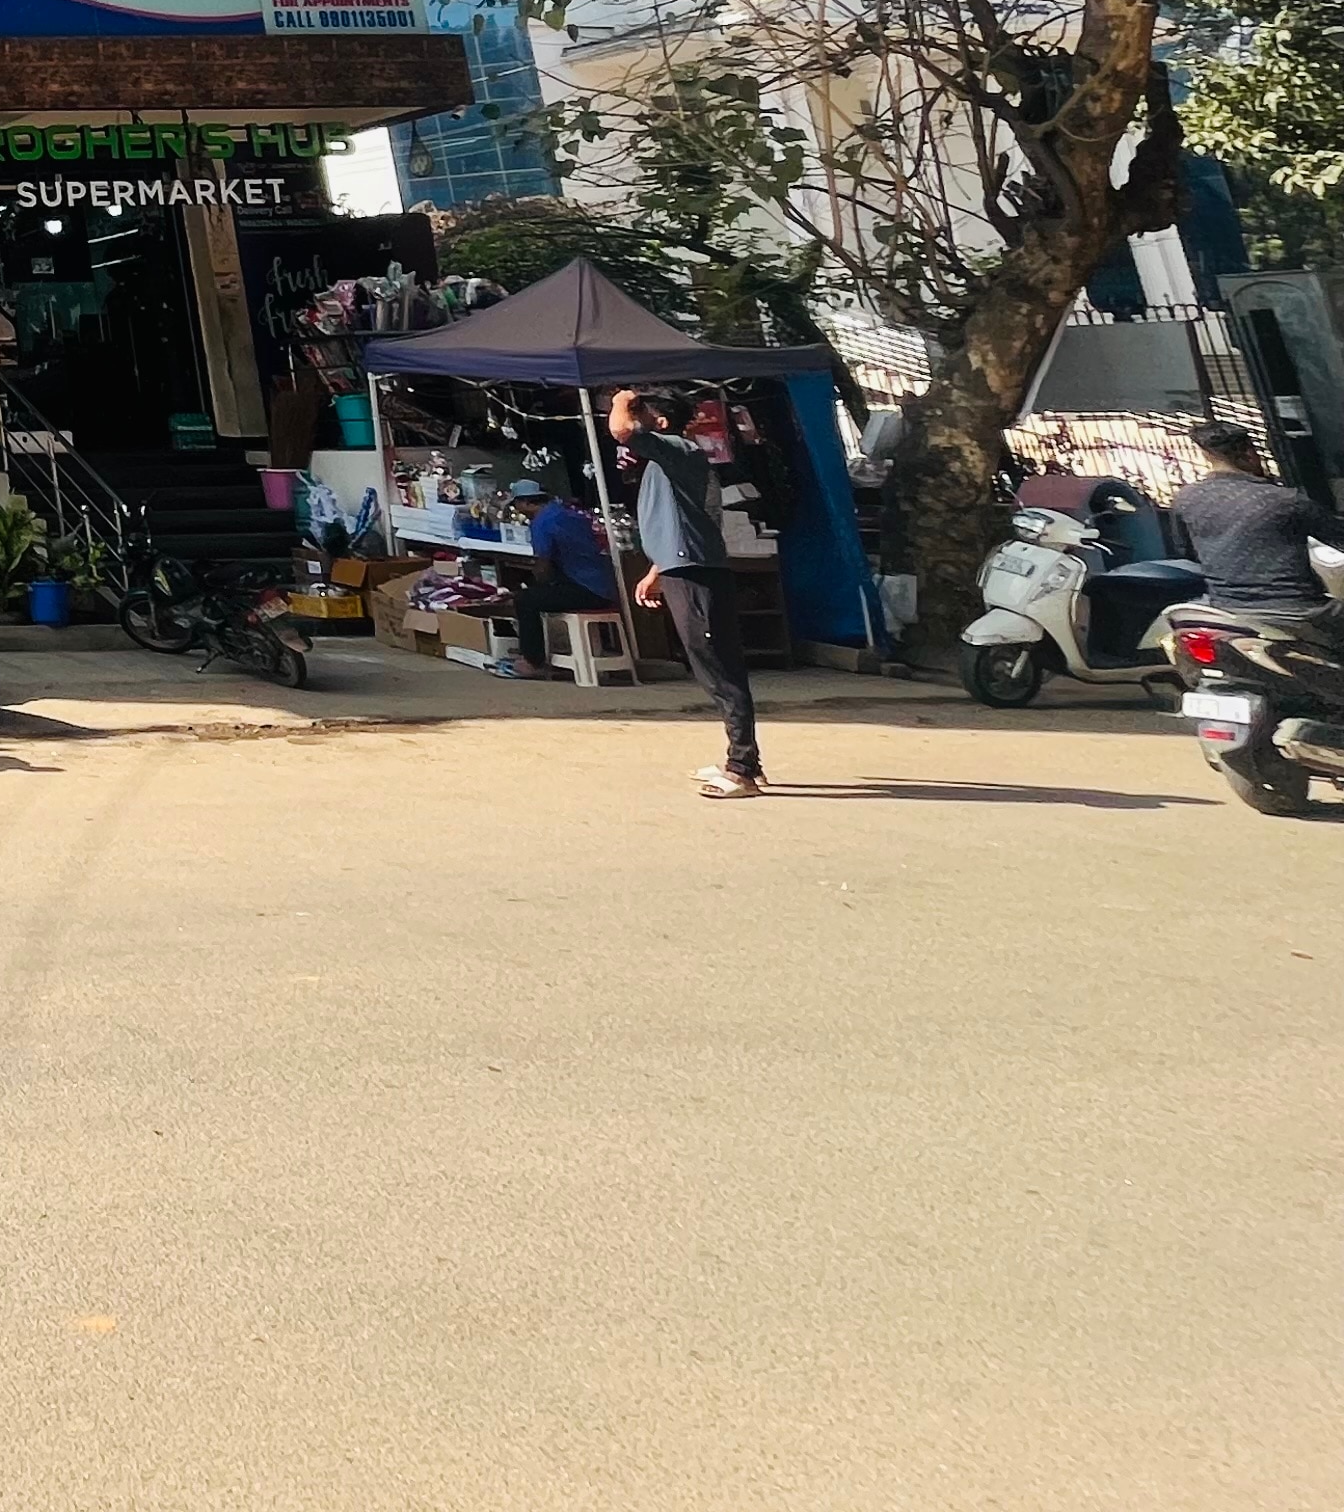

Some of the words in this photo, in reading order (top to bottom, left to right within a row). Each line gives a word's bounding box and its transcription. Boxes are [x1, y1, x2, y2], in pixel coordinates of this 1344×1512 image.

[274, 11, 314, 27] CALL
[244, 123, 355, 157] HUB
[16, 178, 285, 208] SUPERMARKET
